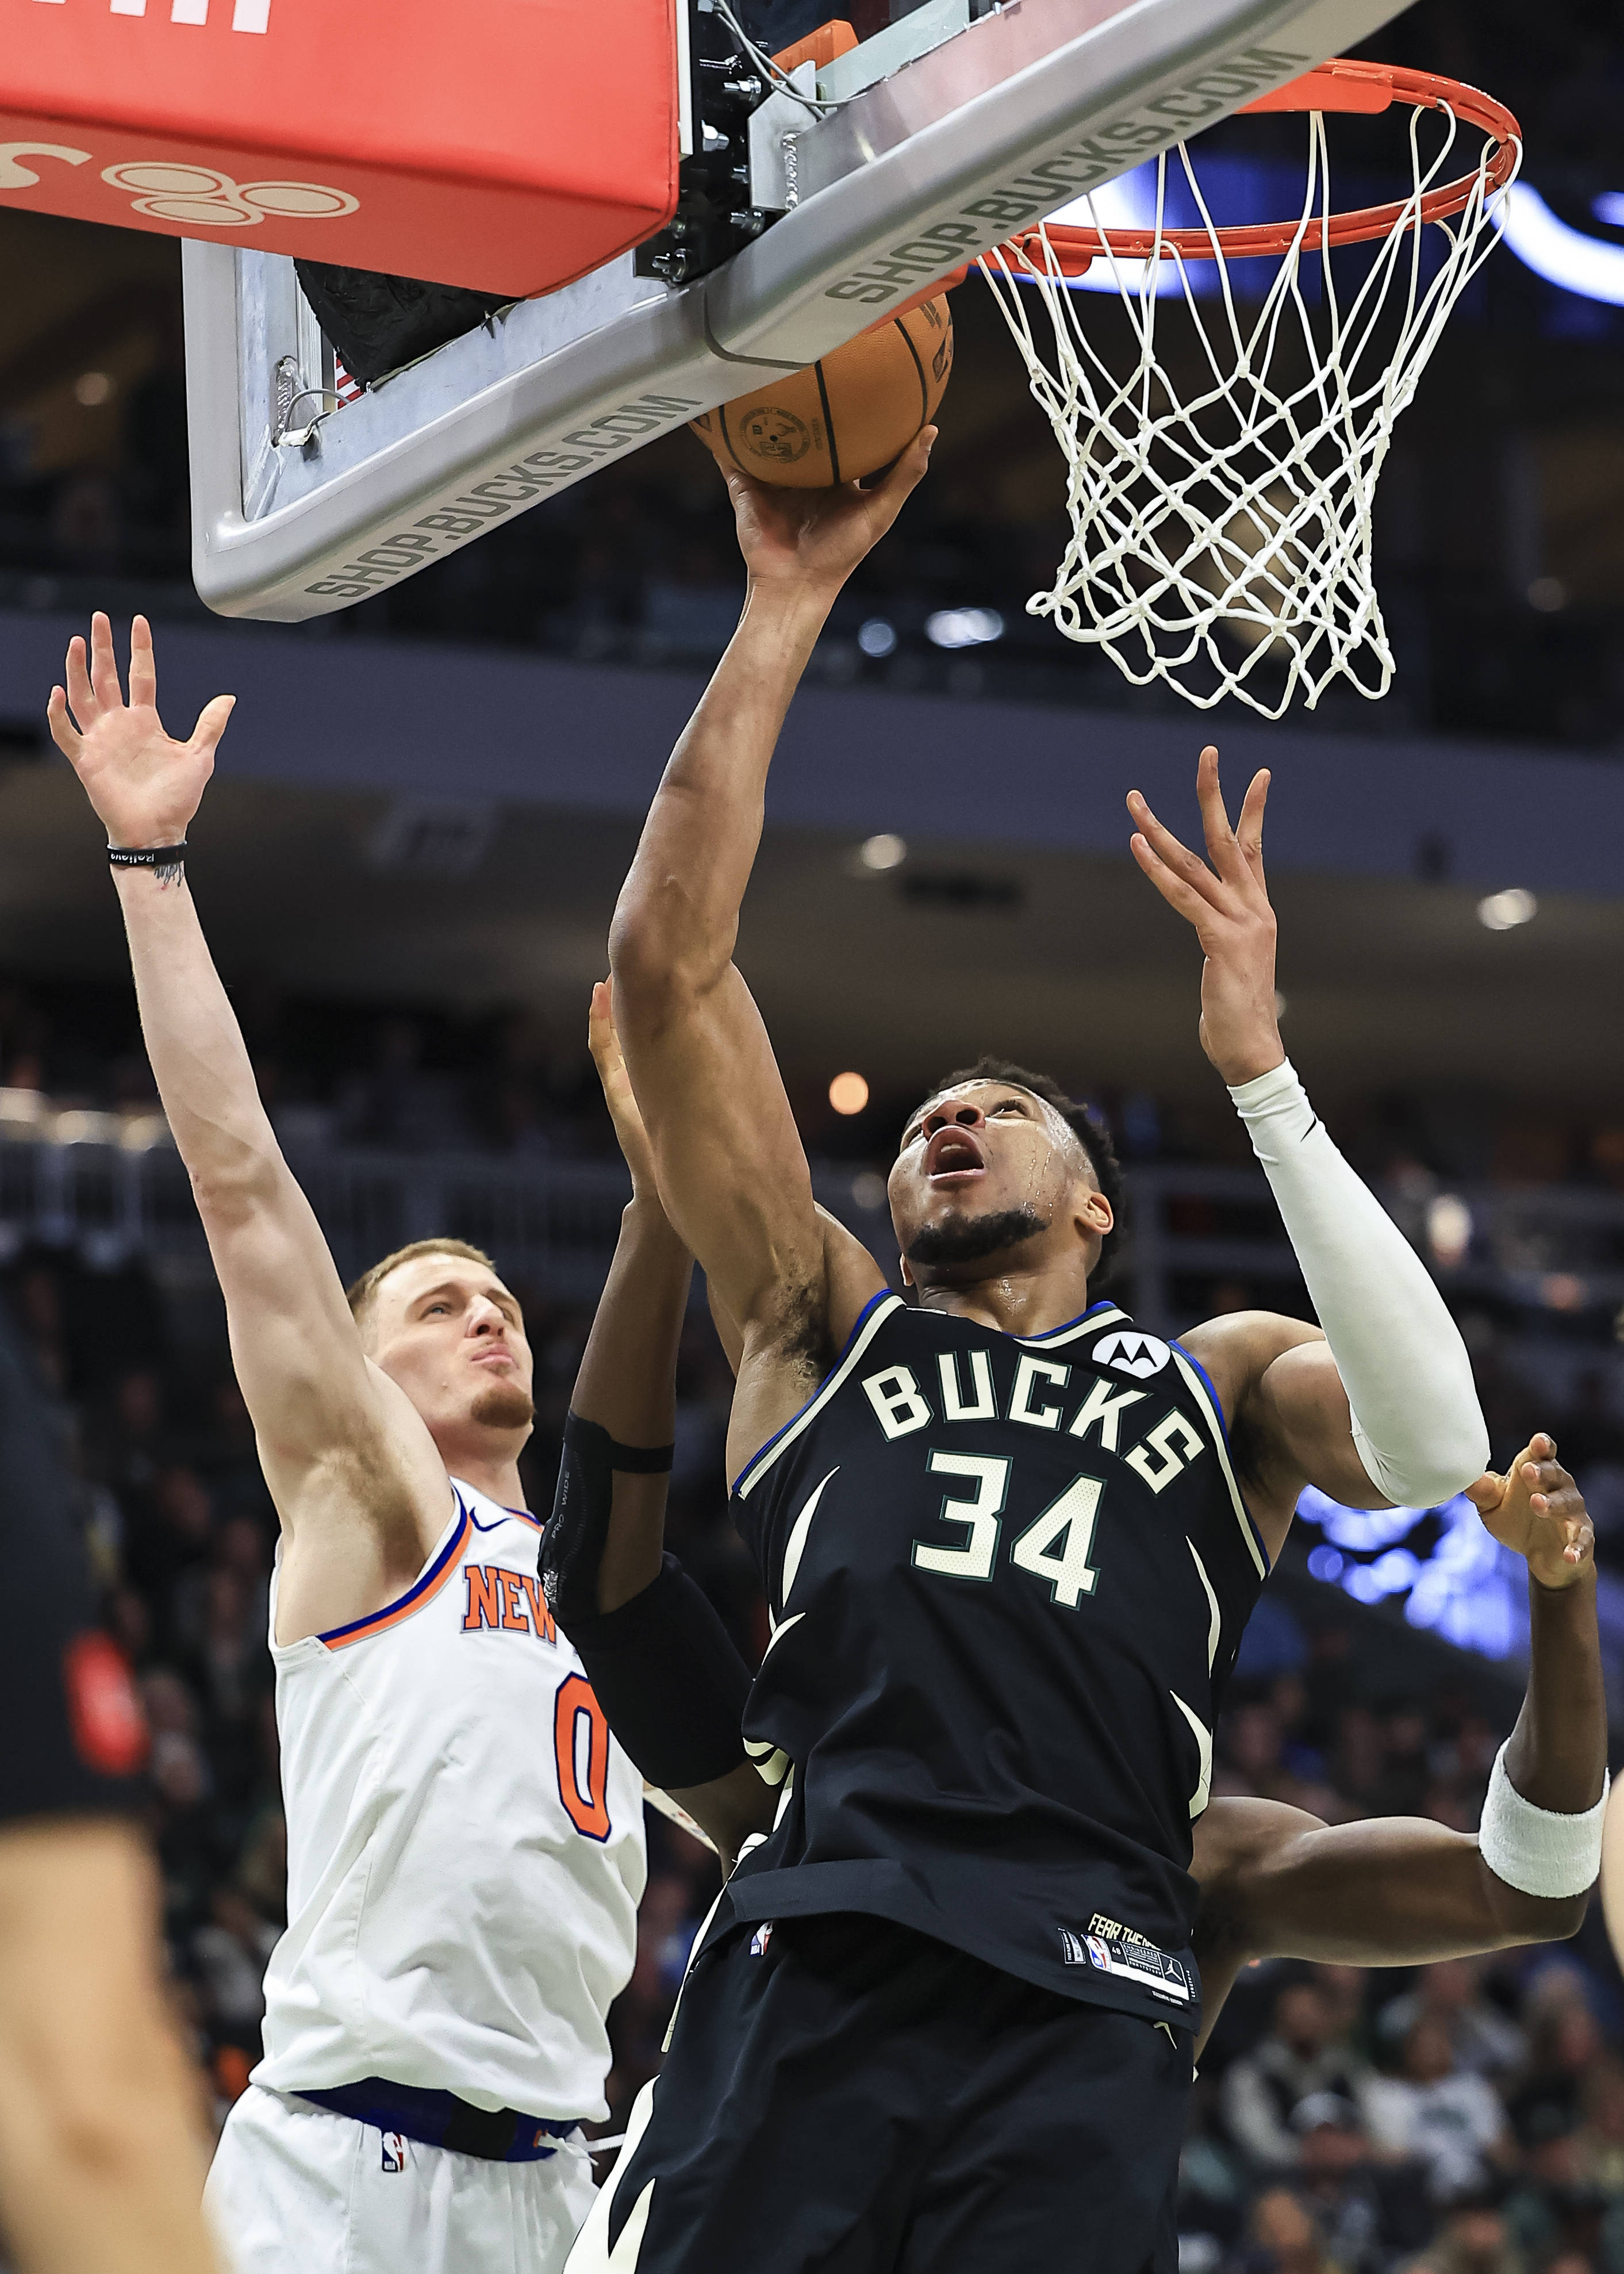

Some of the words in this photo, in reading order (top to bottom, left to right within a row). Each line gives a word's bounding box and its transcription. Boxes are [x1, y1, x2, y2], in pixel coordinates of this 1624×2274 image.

[825, 47, 1312, 303] SHOP.BUCKS.COM
[304, 394, 702, 597] SHOP.BUCKS.COM
[859, 1349, 1207, 1497] BUCKS
[551, 1513, 564, 1539] PRO
[561, 1471, 570, 1505] WIDE
[911, 1448, 1107, 1611] 34
[460, 1564, 557, 1649] NEW
[554, 1671, 612, 1843] 0
[1088, 1913, 1122, 1940] FEAR
[1112, 1946, 1121, 1955] 48
